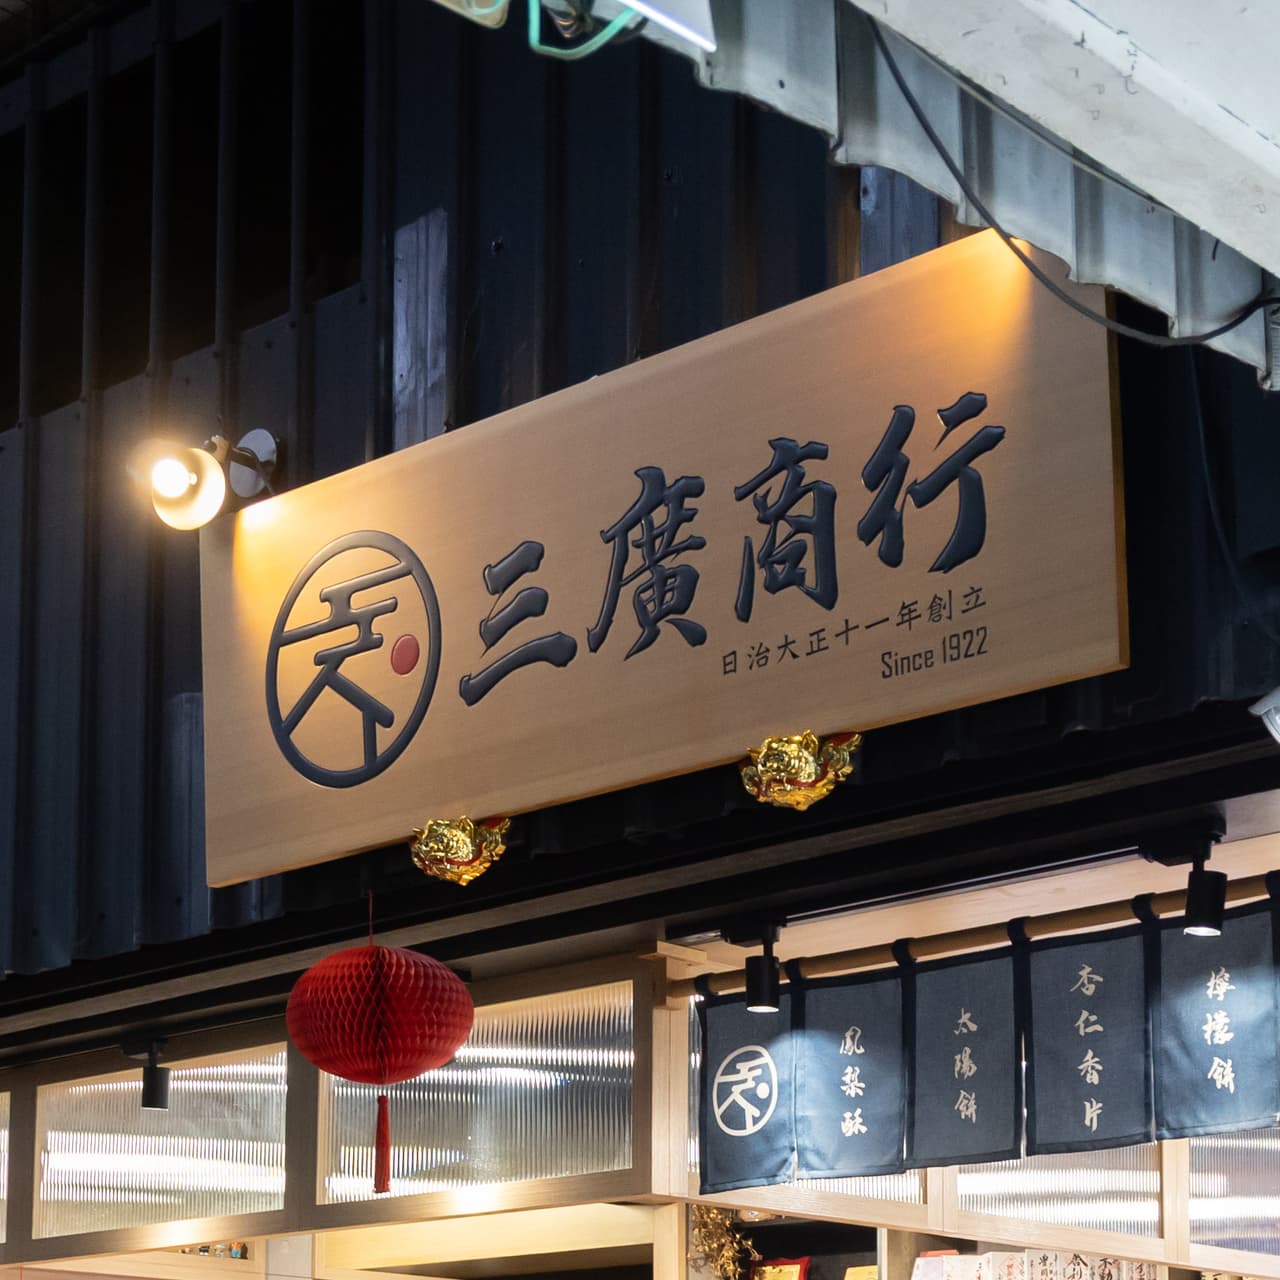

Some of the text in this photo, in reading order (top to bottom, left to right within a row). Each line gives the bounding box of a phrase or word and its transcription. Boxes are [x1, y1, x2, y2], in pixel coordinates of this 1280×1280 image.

[459, 391, 1006, 708] 三廣商行
[721, 585, 988, 677] 日治大正十一年創立
[880, 624, 989, 681] Since 1922
[840, 1025, 868, 1136] 鳳梨酥
[953, 1007, 978, 1124] 太陽餅
[1070, 963, 1105, 1133] 杏仁香片
[1202, 967, 1236, 1094] 檸檬餅
